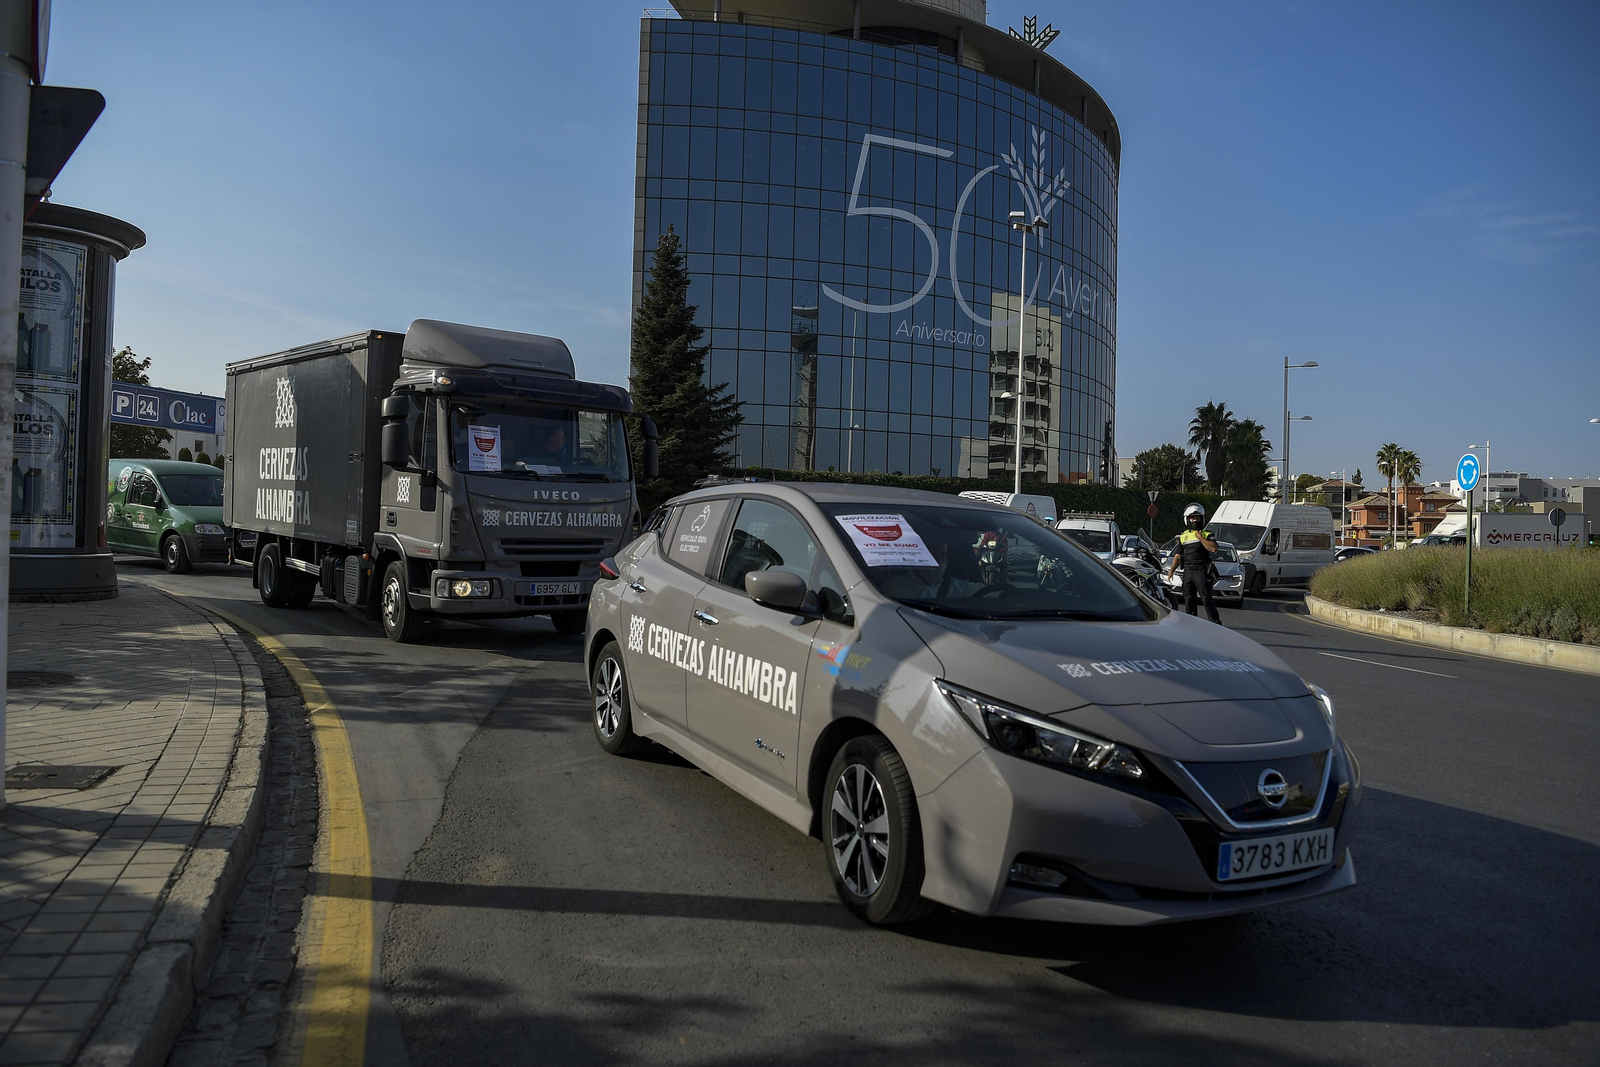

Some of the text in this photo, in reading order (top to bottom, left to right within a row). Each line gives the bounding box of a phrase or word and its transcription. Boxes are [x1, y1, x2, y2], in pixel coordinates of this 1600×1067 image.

[20, 268, 62, 280] ATALLA
[20, 278, 61, 292] ILOS
[895, 319, 986, 348] Aniversario
[117, 395, 134, 413] P
[14, 413, 54, 423] ATALLA
[169, 400, 206, 425] Clac
[14, 423, 54, 435] ILOS
[260, 446, 309, 482] CERVEZAS
[533, 490, 580, 501] IVECO
[255, 488, 311, 526] ALHAMBRA
[505, 511, 622, 527] CERVEZAS ALHAMBRA
[1503, 533, 1580, 542] MERCALUZ
[536, 584, 560, 595] 6957
[647, 623, 798, 715] CERVEZAS ALHAMBRA
[1090, 659, 1265, 675] CERVEZAS ALHAMBRA
[1232, 834, 1329, 874] 3783 KXH
